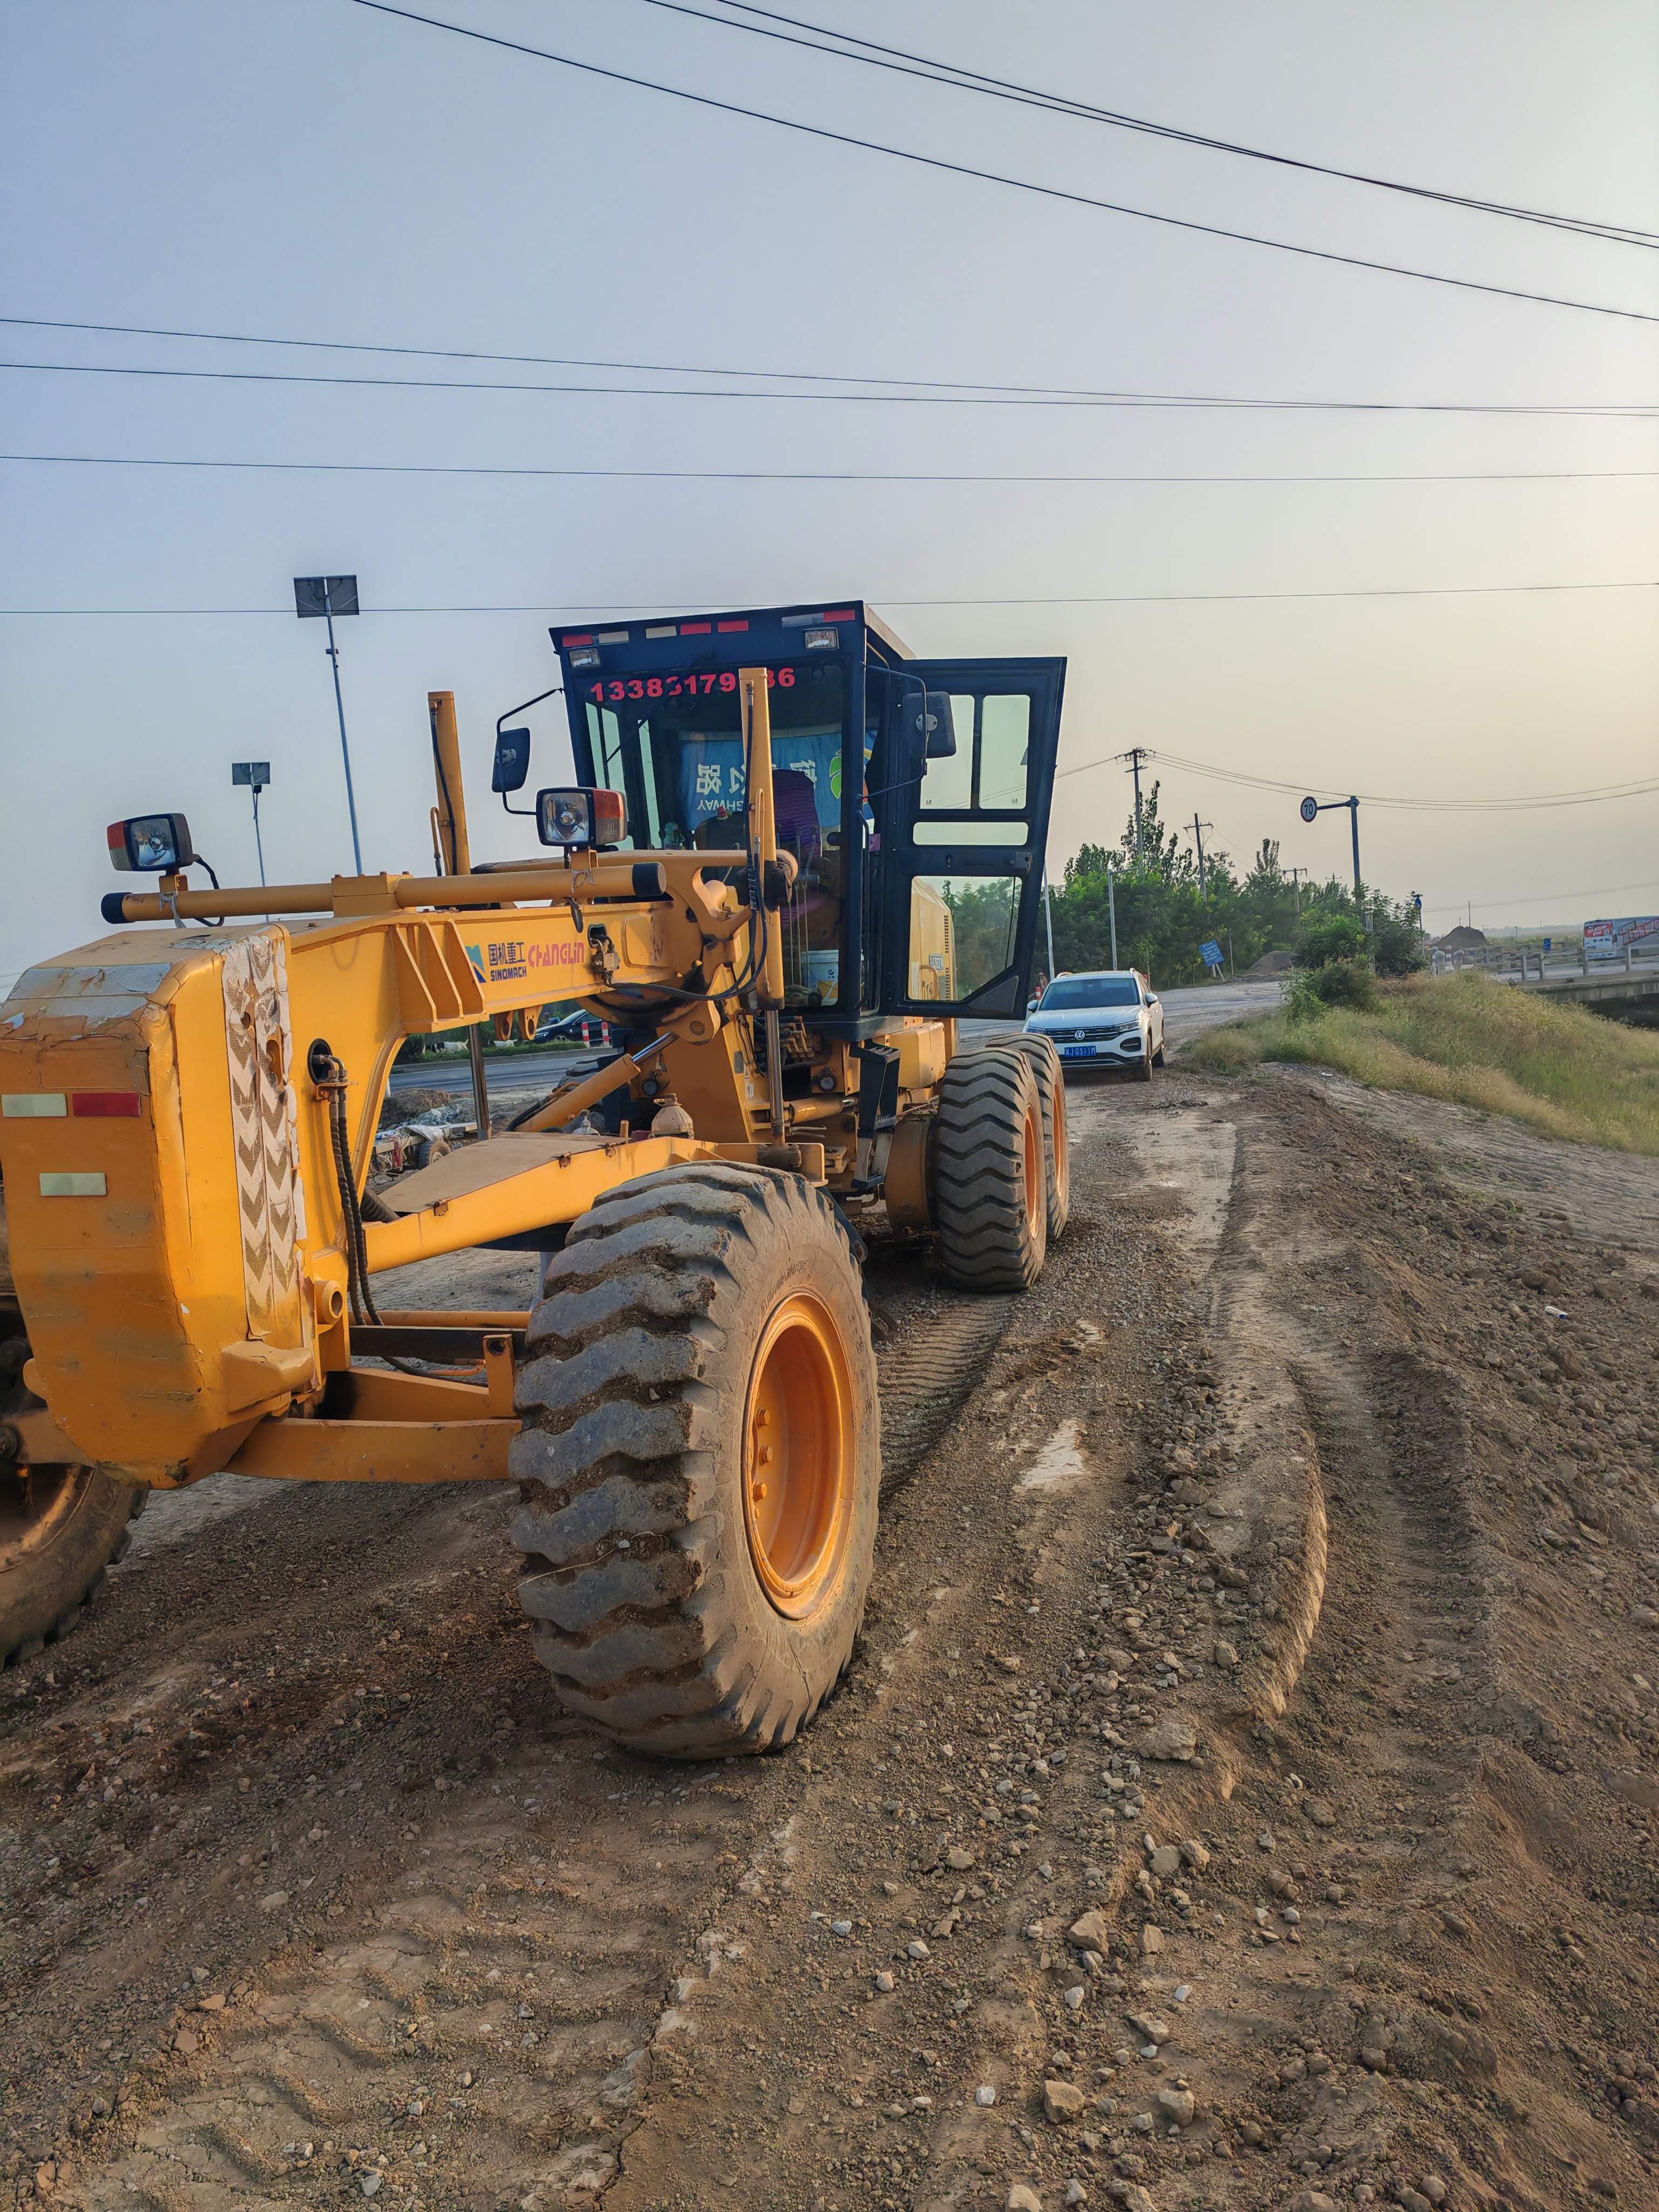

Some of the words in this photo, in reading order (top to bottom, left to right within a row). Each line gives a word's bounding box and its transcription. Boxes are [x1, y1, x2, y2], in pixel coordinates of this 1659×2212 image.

[1304, 804, 1313, 815] 70
[488, 942, 526, 966] 国机重工
[490, 966, 527, 982] SINOMACH
